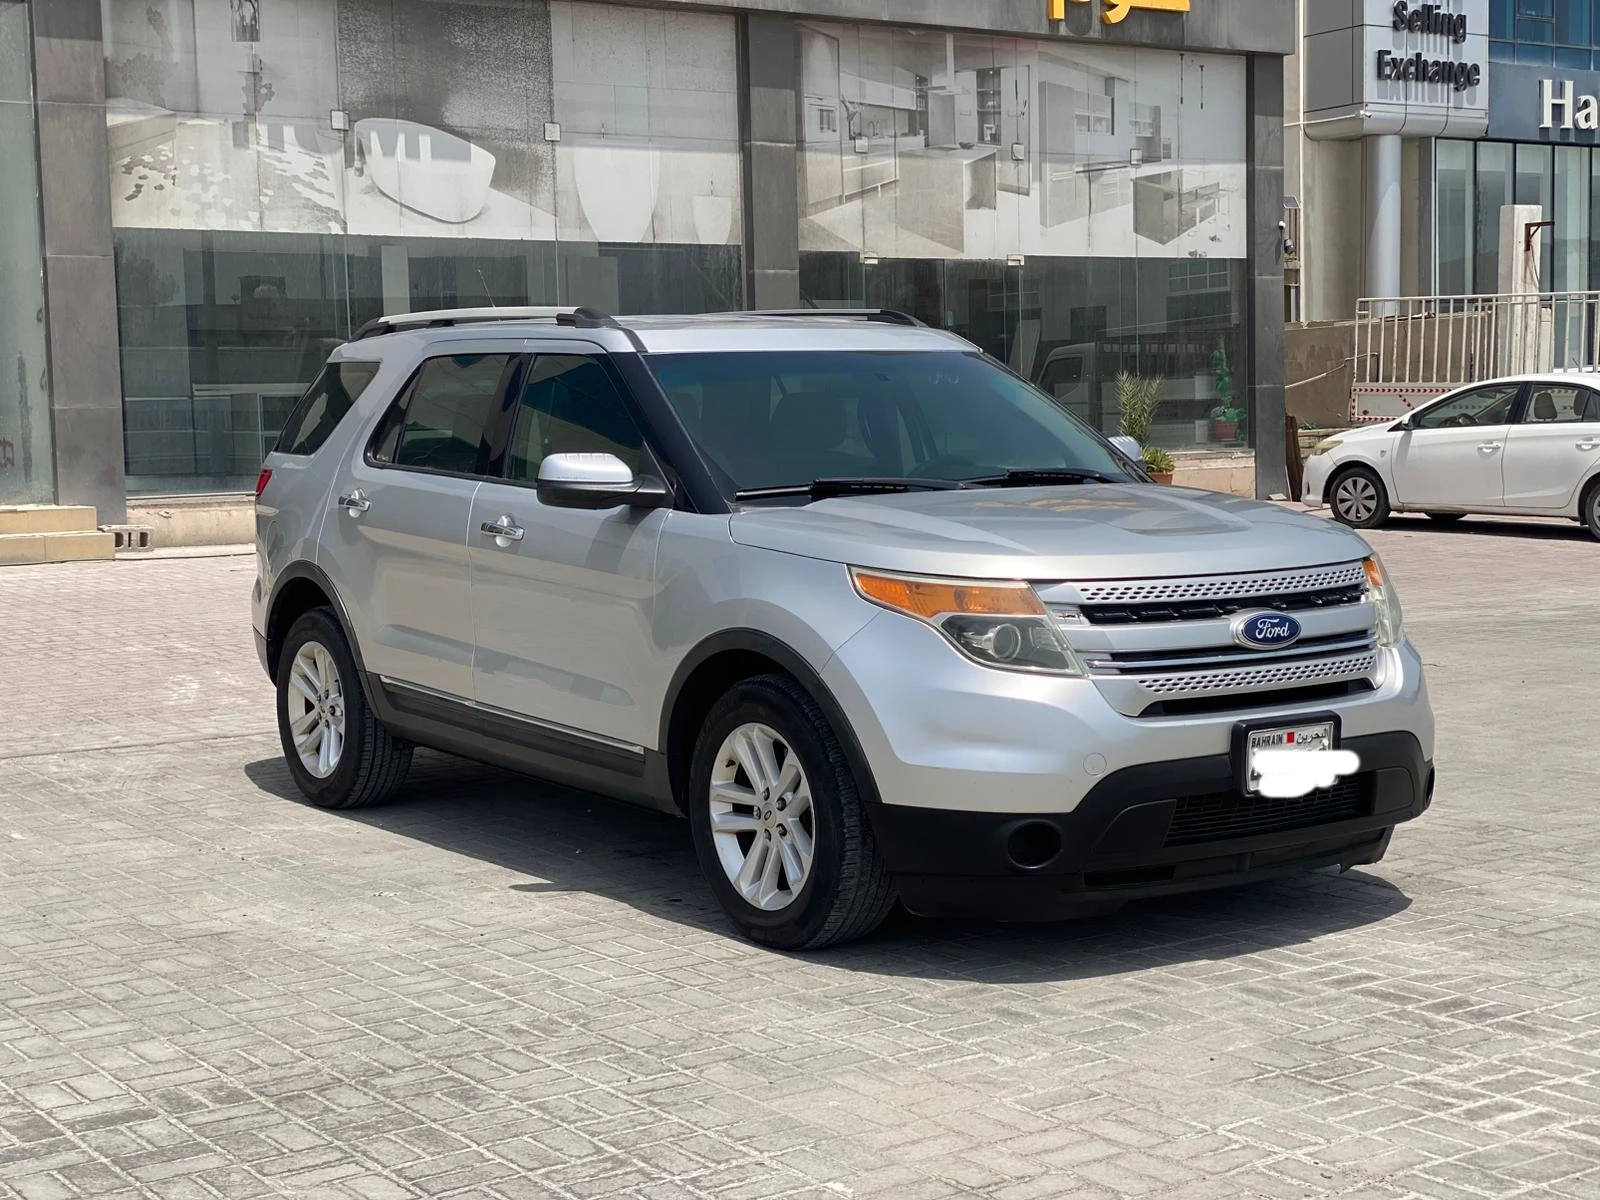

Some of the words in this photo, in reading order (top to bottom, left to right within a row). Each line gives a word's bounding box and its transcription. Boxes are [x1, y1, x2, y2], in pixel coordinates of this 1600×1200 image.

[1393, 0, 1467, 43] Selling
[1377, 49, 1480, 91] Exchange
[1255, 618, 1290, 639] Ford
[1251, 733, 1284, 748] BAHRAIN
[1296, 727, 1329, 745] البحرين
